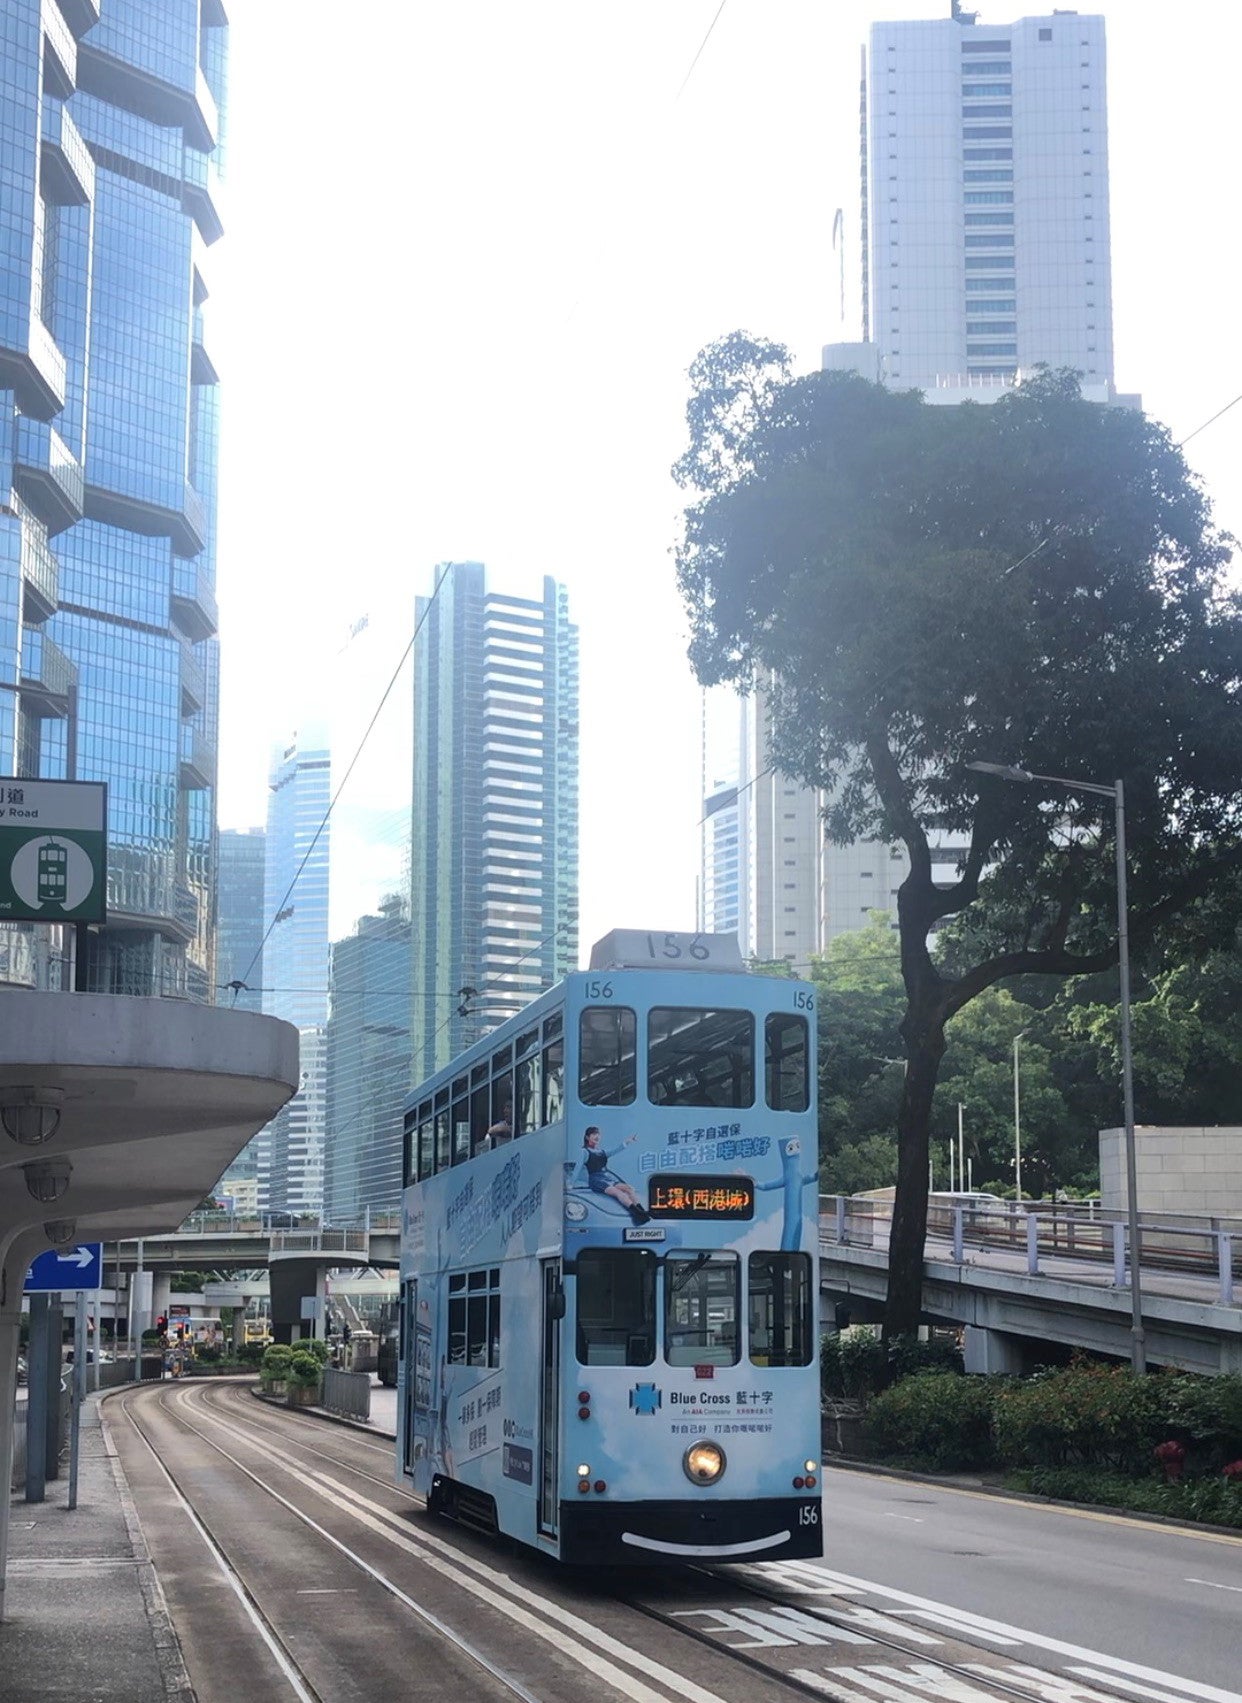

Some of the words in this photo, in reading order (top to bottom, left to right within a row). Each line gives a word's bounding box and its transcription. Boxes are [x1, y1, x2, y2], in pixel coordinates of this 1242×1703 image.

[0, 788, 24, 804] 道
[9, 808, 38, 818] Road
[647, 933, 710, 960] 156
[585, 981, 613, 999] 156
[793, 991, 814, 1011] 156
[667, 1123, 741, 1145] 藍十字自選保
[629, 1230, 642, 1238] JUST
[645, 1230, 662, 1238] RIGHT
[670, 1392, 697, 1404] Blue
[699, 1392, 731, 1404] Cross
[736, 1391, 773, 1405] 藍十字
[799, 1505, 818, 1525] 156
[667, 1606, 1023, 1649] LANE
